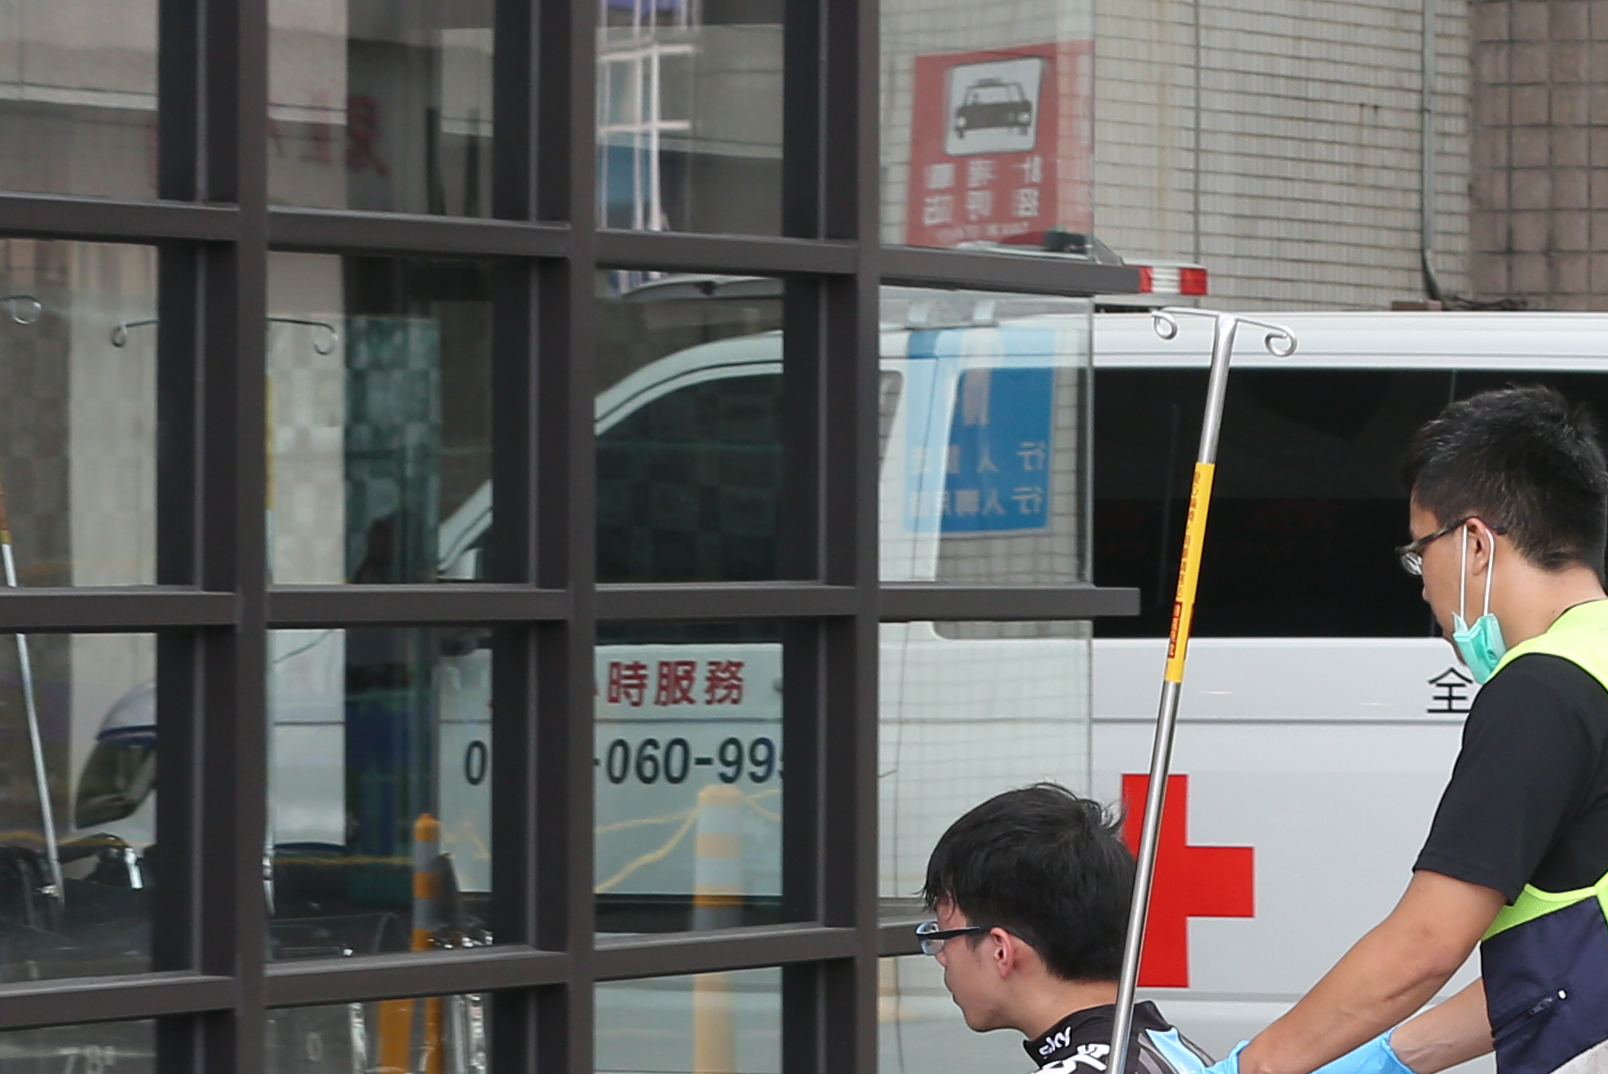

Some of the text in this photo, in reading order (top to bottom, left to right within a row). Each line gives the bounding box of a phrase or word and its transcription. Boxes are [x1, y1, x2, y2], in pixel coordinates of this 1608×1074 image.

[595, 659, 746, 707] 時服務
[1426, 666, 1474, 714] 全
[594, 737, 784, 785] 060-99
